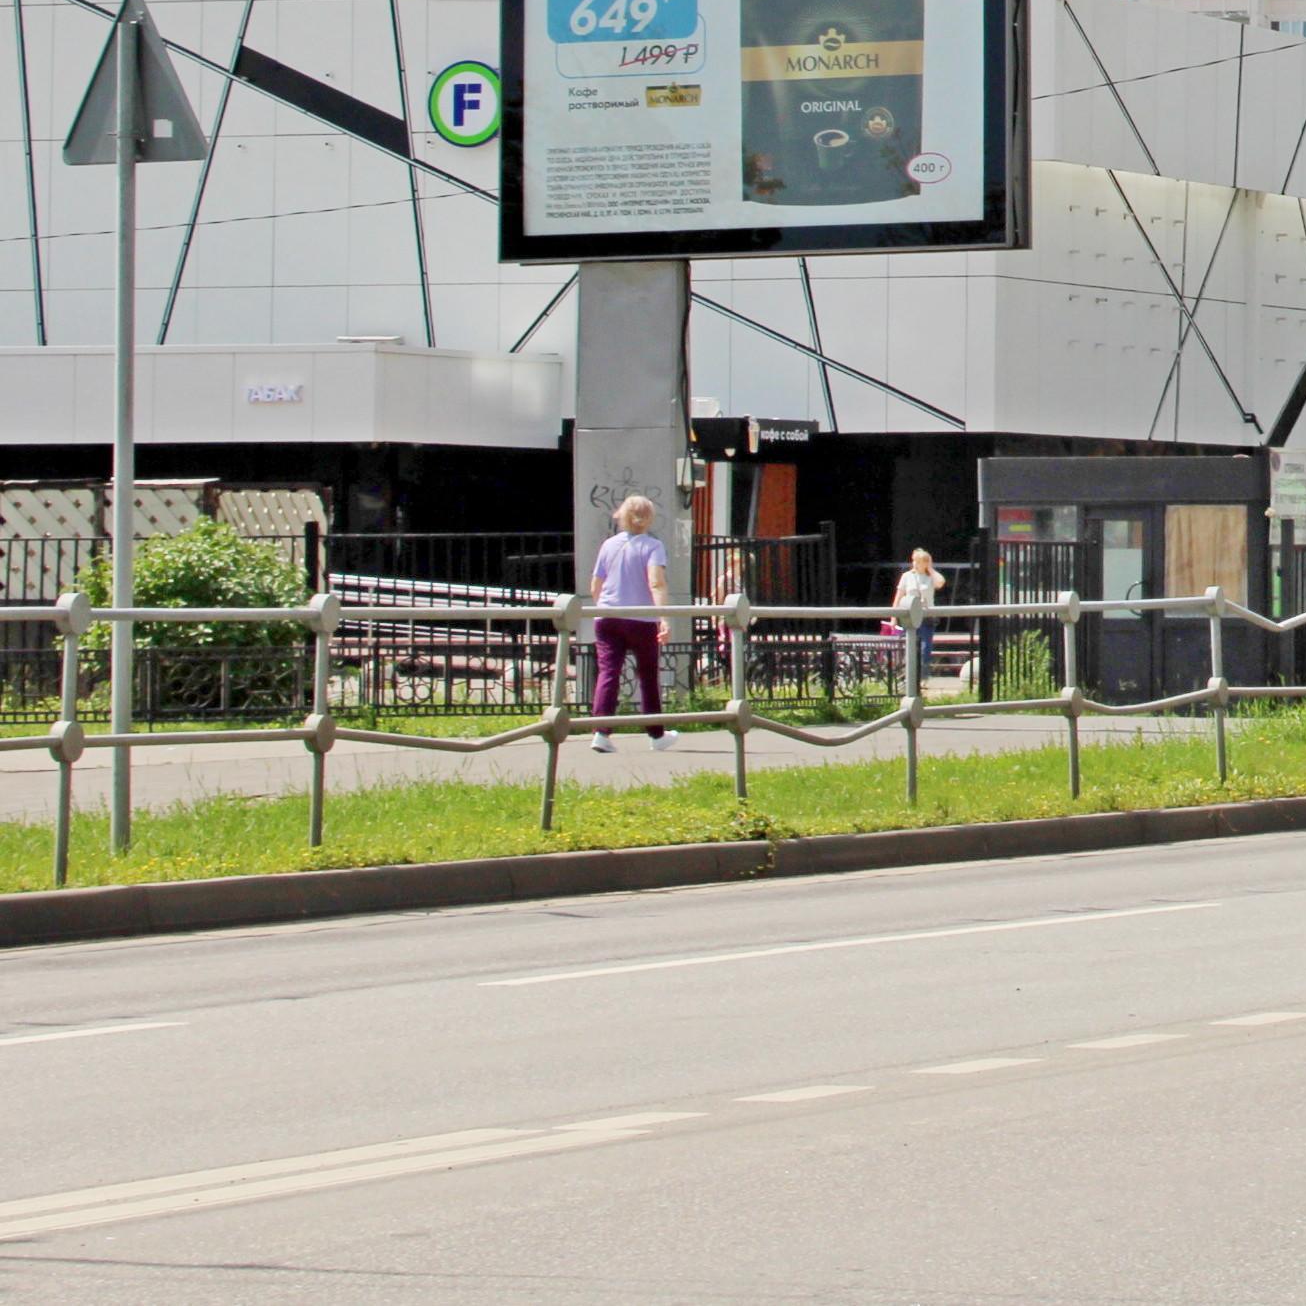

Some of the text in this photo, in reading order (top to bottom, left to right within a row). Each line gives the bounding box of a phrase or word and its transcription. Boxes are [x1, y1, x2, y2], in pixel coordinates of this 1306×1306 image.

[785, 53, 880, 72] MONARCH
[568, 86, 599, 98] Кофе
[453, 83, 482, 127] F
[801, 100, 862, 114] ORIGINAL
[913, 162, 936, 173] 400
